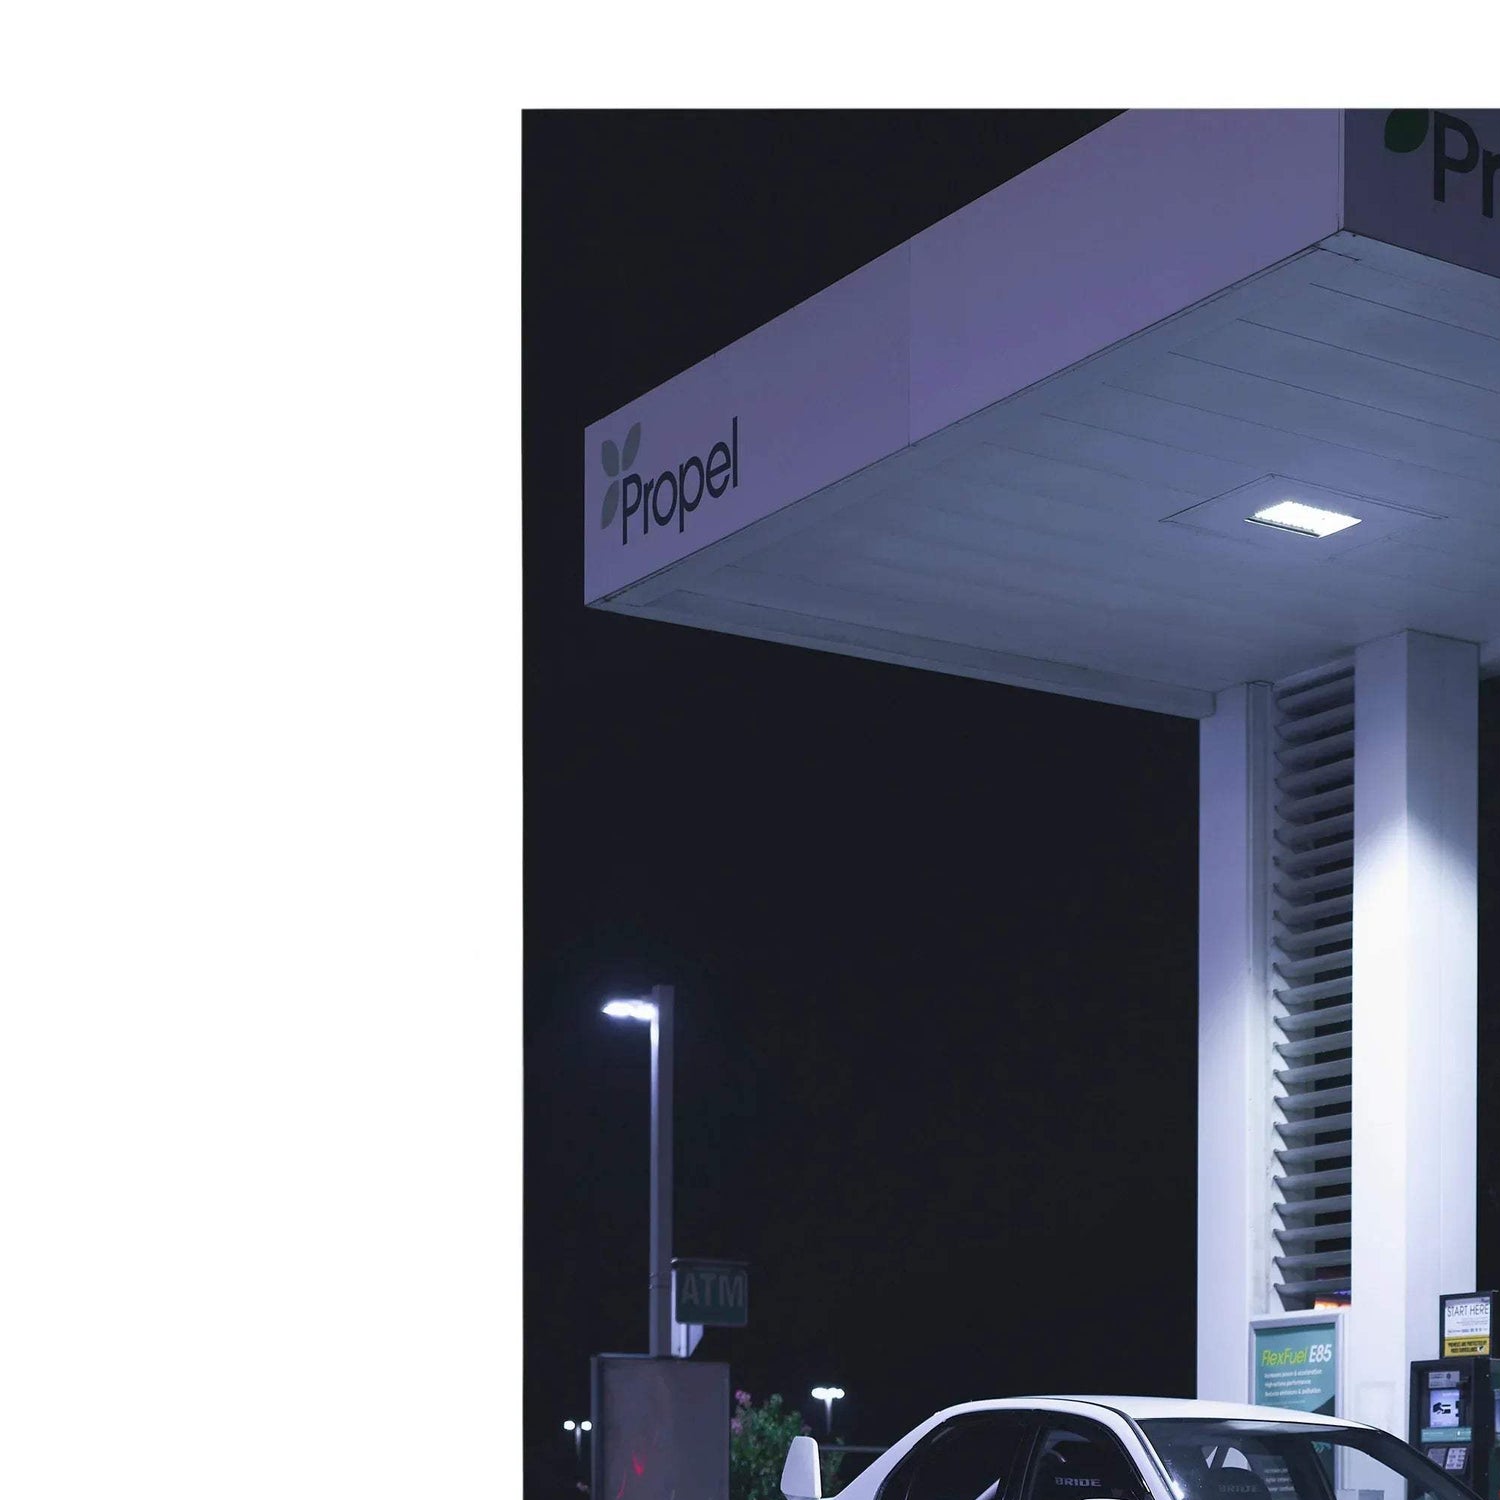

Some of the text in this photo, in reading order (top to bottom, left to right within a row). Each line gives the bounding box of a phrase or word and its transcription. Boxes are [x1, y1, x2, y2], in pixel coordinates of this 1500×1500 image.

[622, 416, 738, 545] Propel
[681, 1273, 743, 1307] ATM
[1447, 1303, 1489, 1317] START HERE
[1262, 1343, 1333, 1367] FlexFuel E85
[1054, 1476, 1102, 1487] BRIDE
